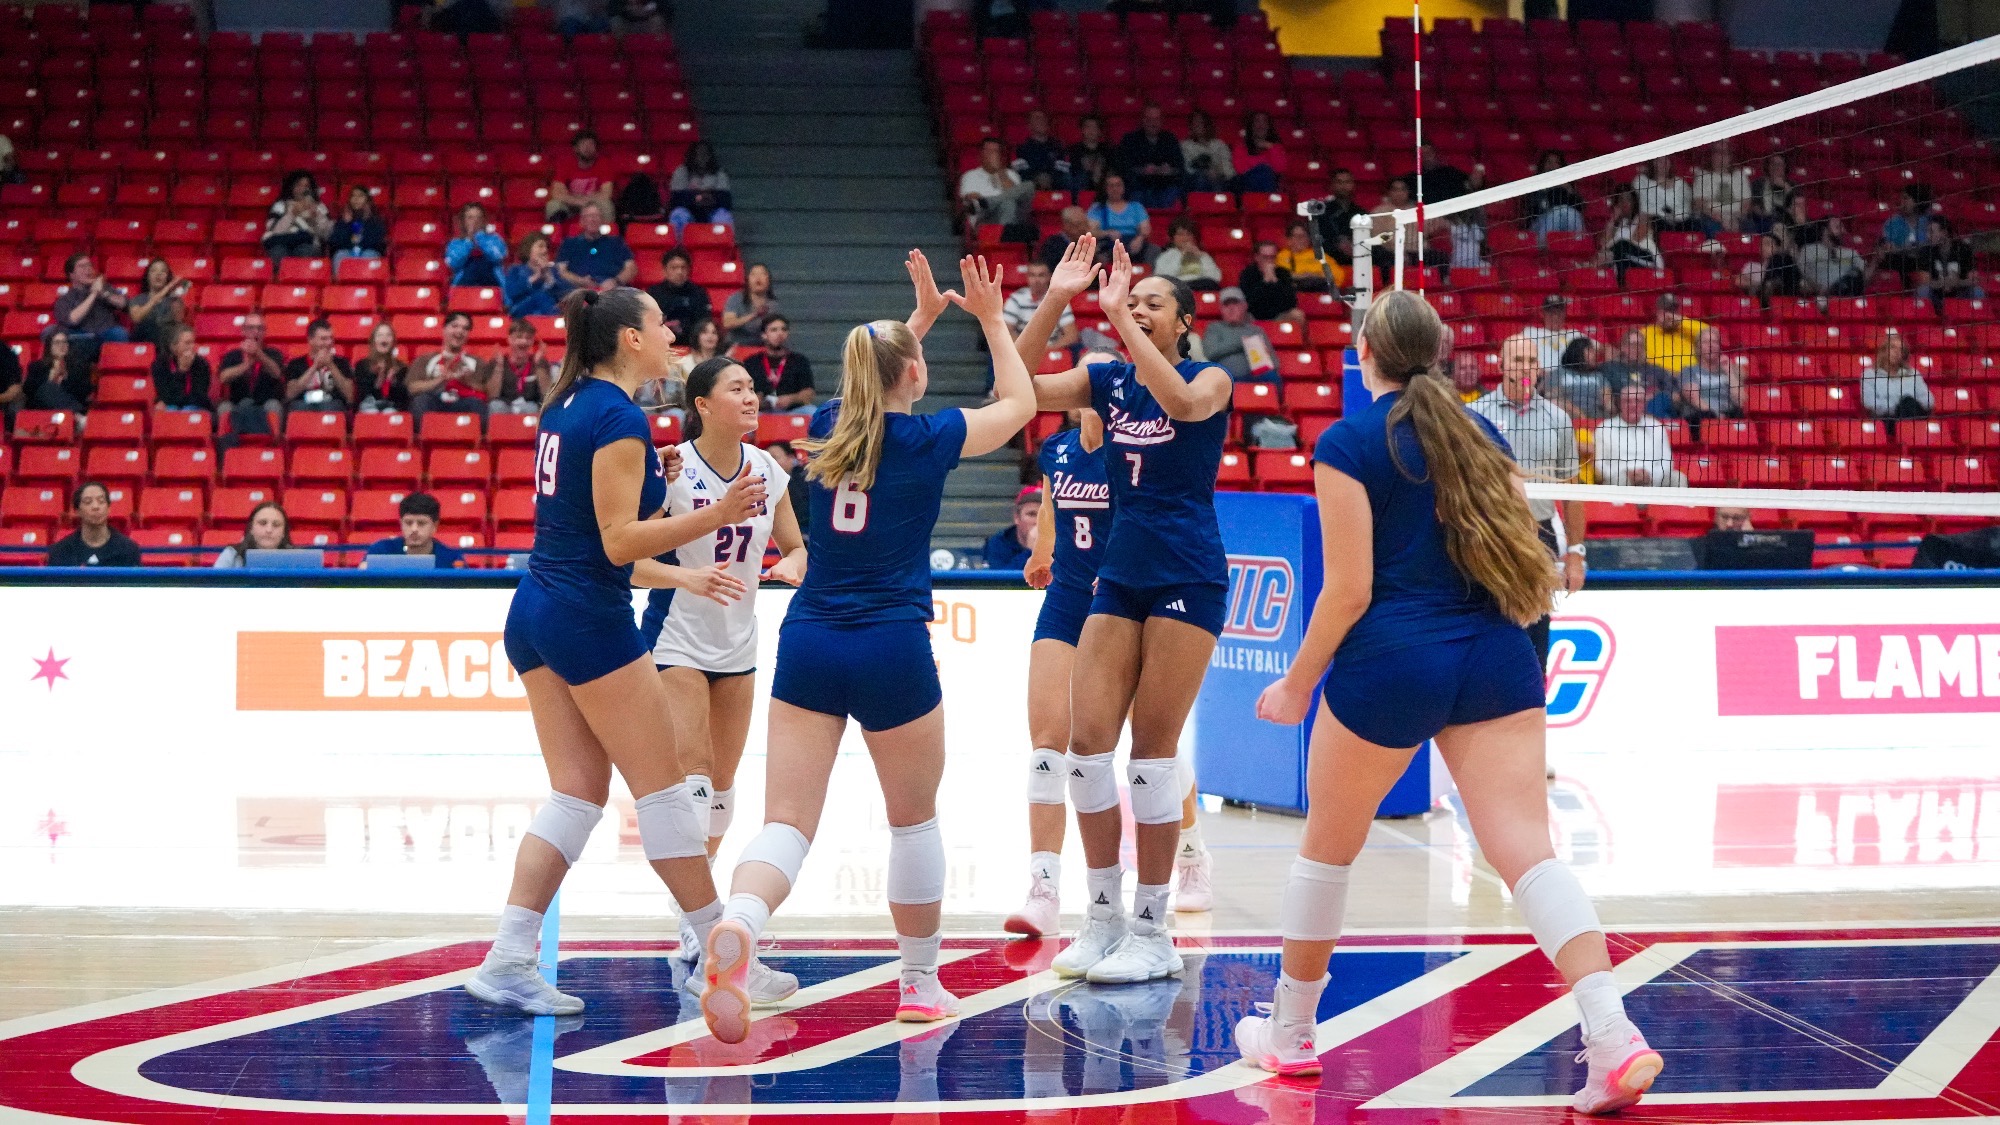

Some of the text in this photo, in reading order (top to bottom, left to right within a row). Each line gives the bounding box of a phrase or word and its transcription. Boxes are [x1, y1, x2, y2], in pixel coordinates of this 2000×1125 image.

[1107, 403, 1171, 437] Flames
[535, 432, 560, 497] 19
[1125, 452, 1142, 487] 7
[833, 470, 869, 533] 6
[714, 525, 753, 563] 27
[1074, 515, 1093, 550] 8
